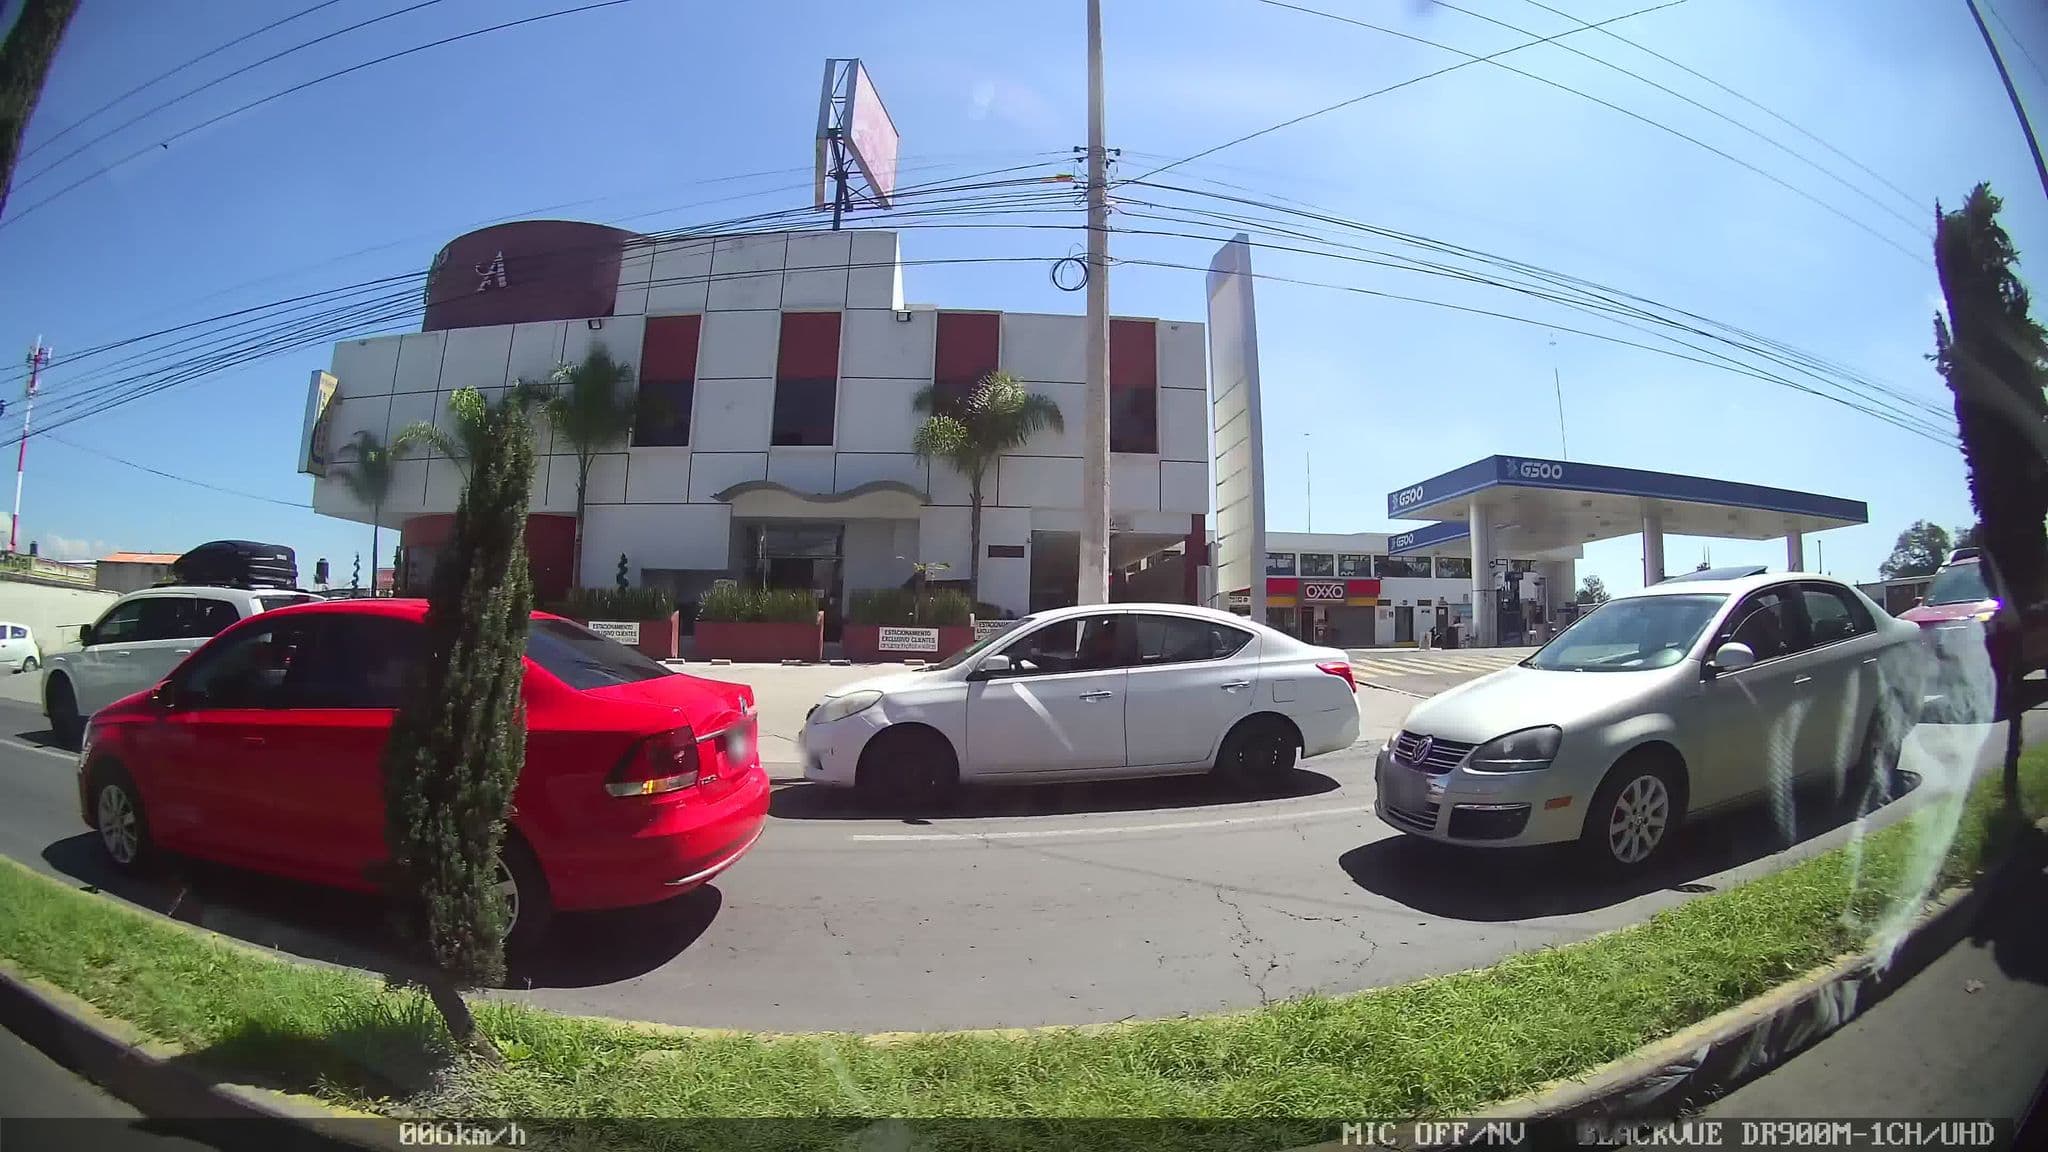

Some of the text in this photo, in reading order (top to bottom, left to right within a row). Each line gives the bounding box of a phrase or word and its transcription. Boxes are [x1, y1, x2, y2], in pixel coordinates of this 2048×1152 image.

[1521, 462, 1563, 479] G500
[1400, 486, 1423, 506] G500
[1397, 533, 1414, 547] G500
[1306, 585, 1344, 598] OXXO
